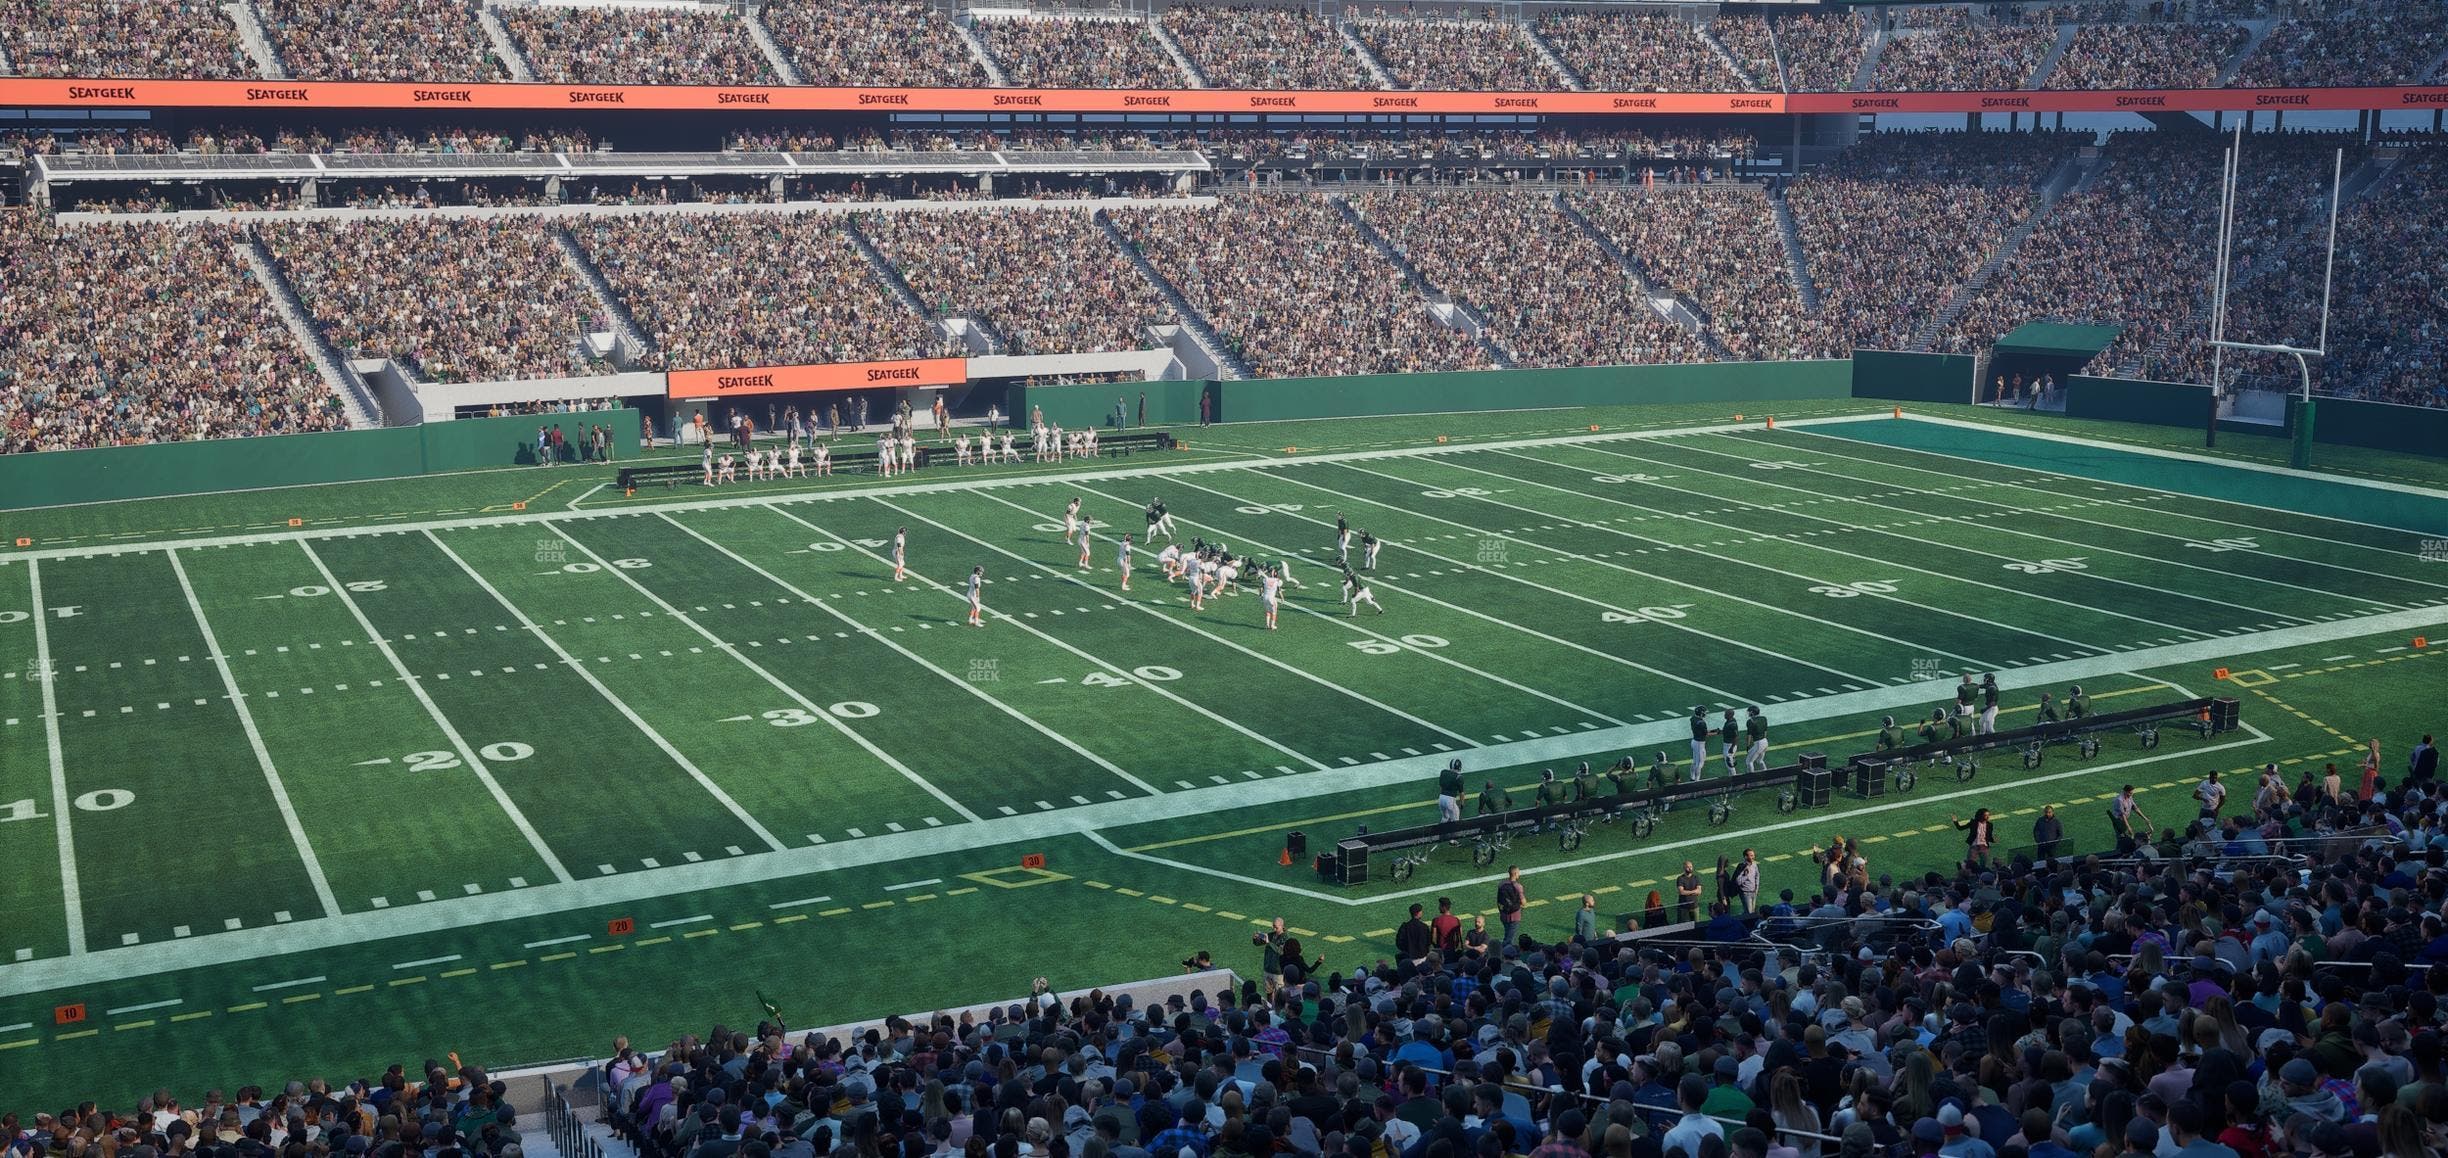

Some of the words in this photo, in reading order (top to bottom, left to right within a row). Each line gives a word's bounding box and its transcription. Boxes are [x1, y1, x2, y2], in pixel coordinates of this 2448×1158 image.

[68, 85, 136, 100] SEATGEEK
[246, 88, 309, 101] SEATGEEK
[413, 90, 472, 102] SEATGEEK
[569, 91, 625, 104] SEATGEEK
[717, 92, 770, 105] SEATGEEK
[858, 94, 909, 105] SEATGEEK
[993, 95, 1042, 106] SEATGEEK
[1124, 95, 1170, 107] SEATGEEK
[1250, 96, 1296, 107] SEATGEEK
[1373, 97, 1418, 108] SEATGEEK
[1494, 97, 1538, 108] SEATGEEK
[1613, 98, 1656, 108] SEATGEEK
[1730, 98, 1772, 109] SEATGEEK
[1852, 98, 1899, 109] SEATGEEK
[1981, 96, 2030, 107] SEATGEEK
[2116, 95, 2166, 107] SEATGEEK
[2255, 94, 2310, 105] SEATGEEK
[868, 367, 920, 382] SEATGEEK
[717, 374, 774, 390] SEATGEEK
[1347, 634, 1450, 655] 50
[761, 701, 881, 727] 30
[403, 741, 534, 772] 20
[1028, 855, 1041, 867] 30
[615, 920, 629, 932] 20
[63, 1006, 77, 1019] 10
